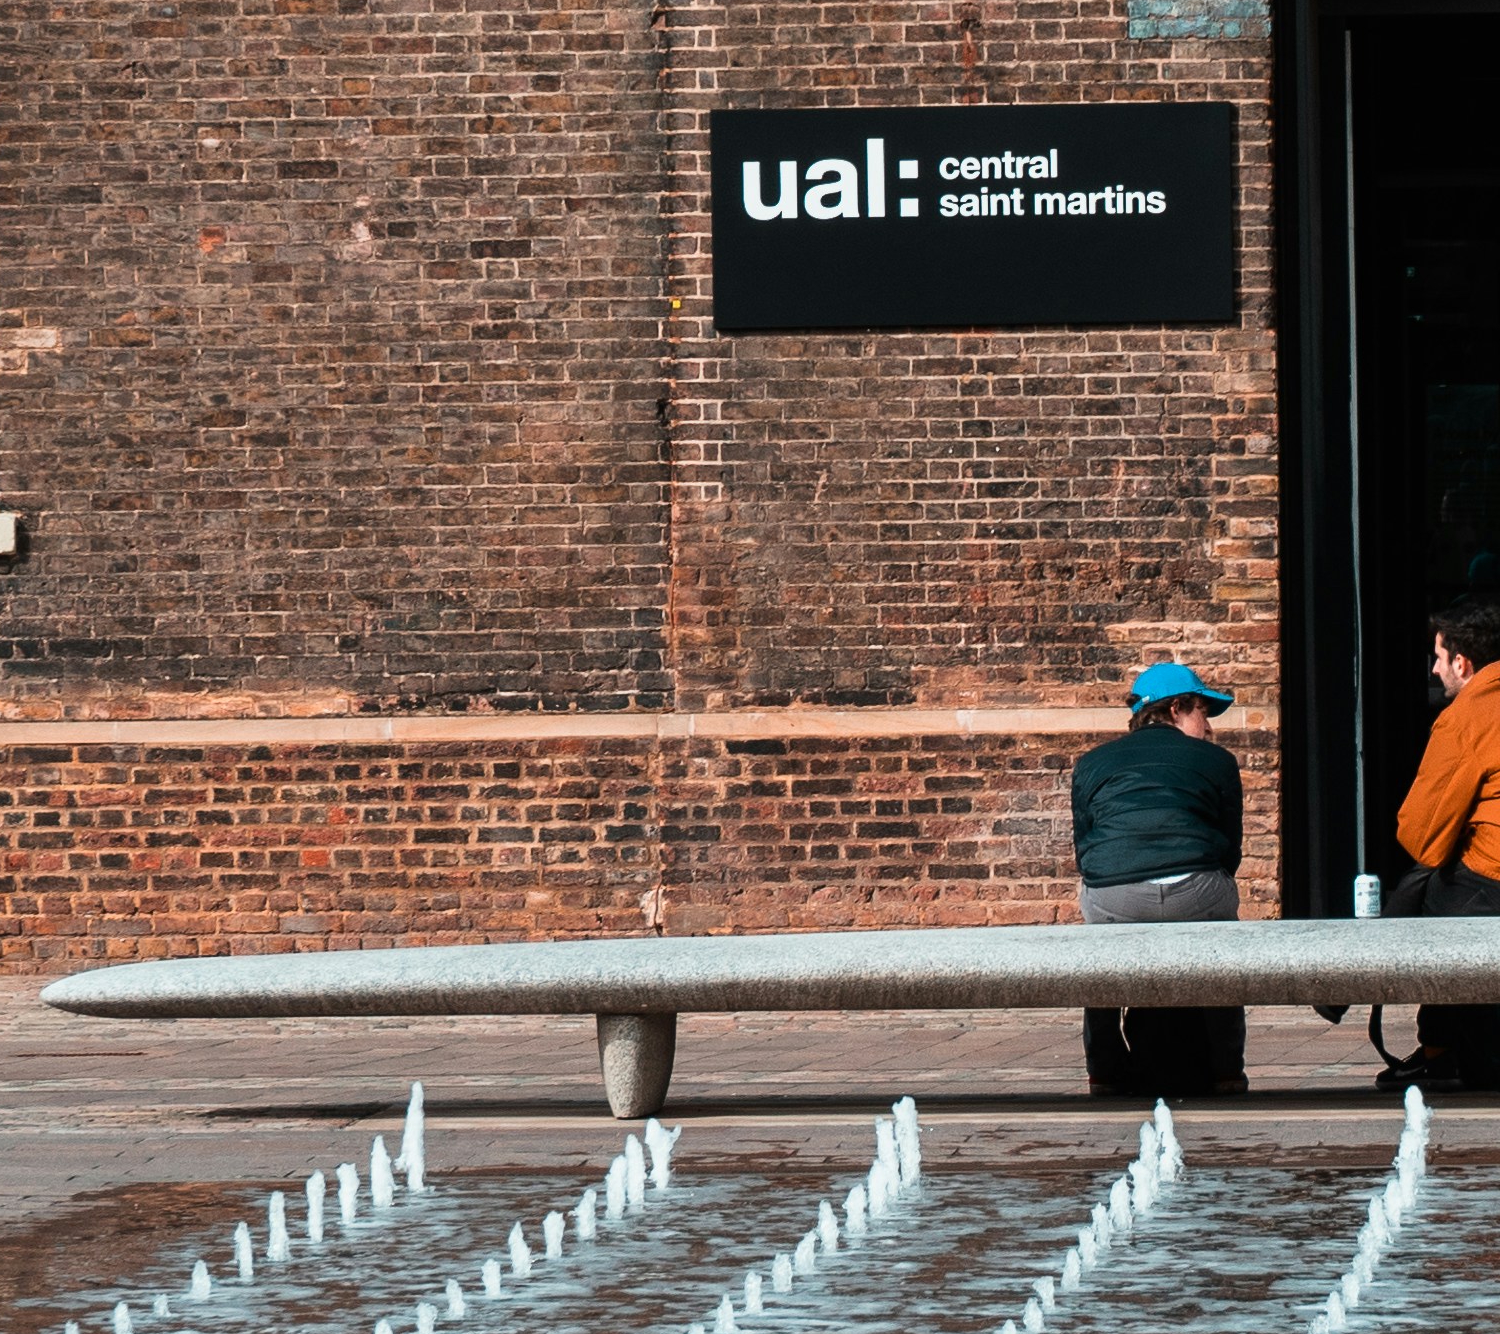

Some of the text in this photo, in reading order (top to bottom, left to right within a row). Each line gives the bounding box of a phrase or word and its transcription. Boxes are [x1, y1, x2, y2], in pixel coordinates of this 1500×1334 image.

[741, 137, 920, 221] ual:
[938, 148, 1058, 181] central
[939, 184, 1167, 218] saint martins
